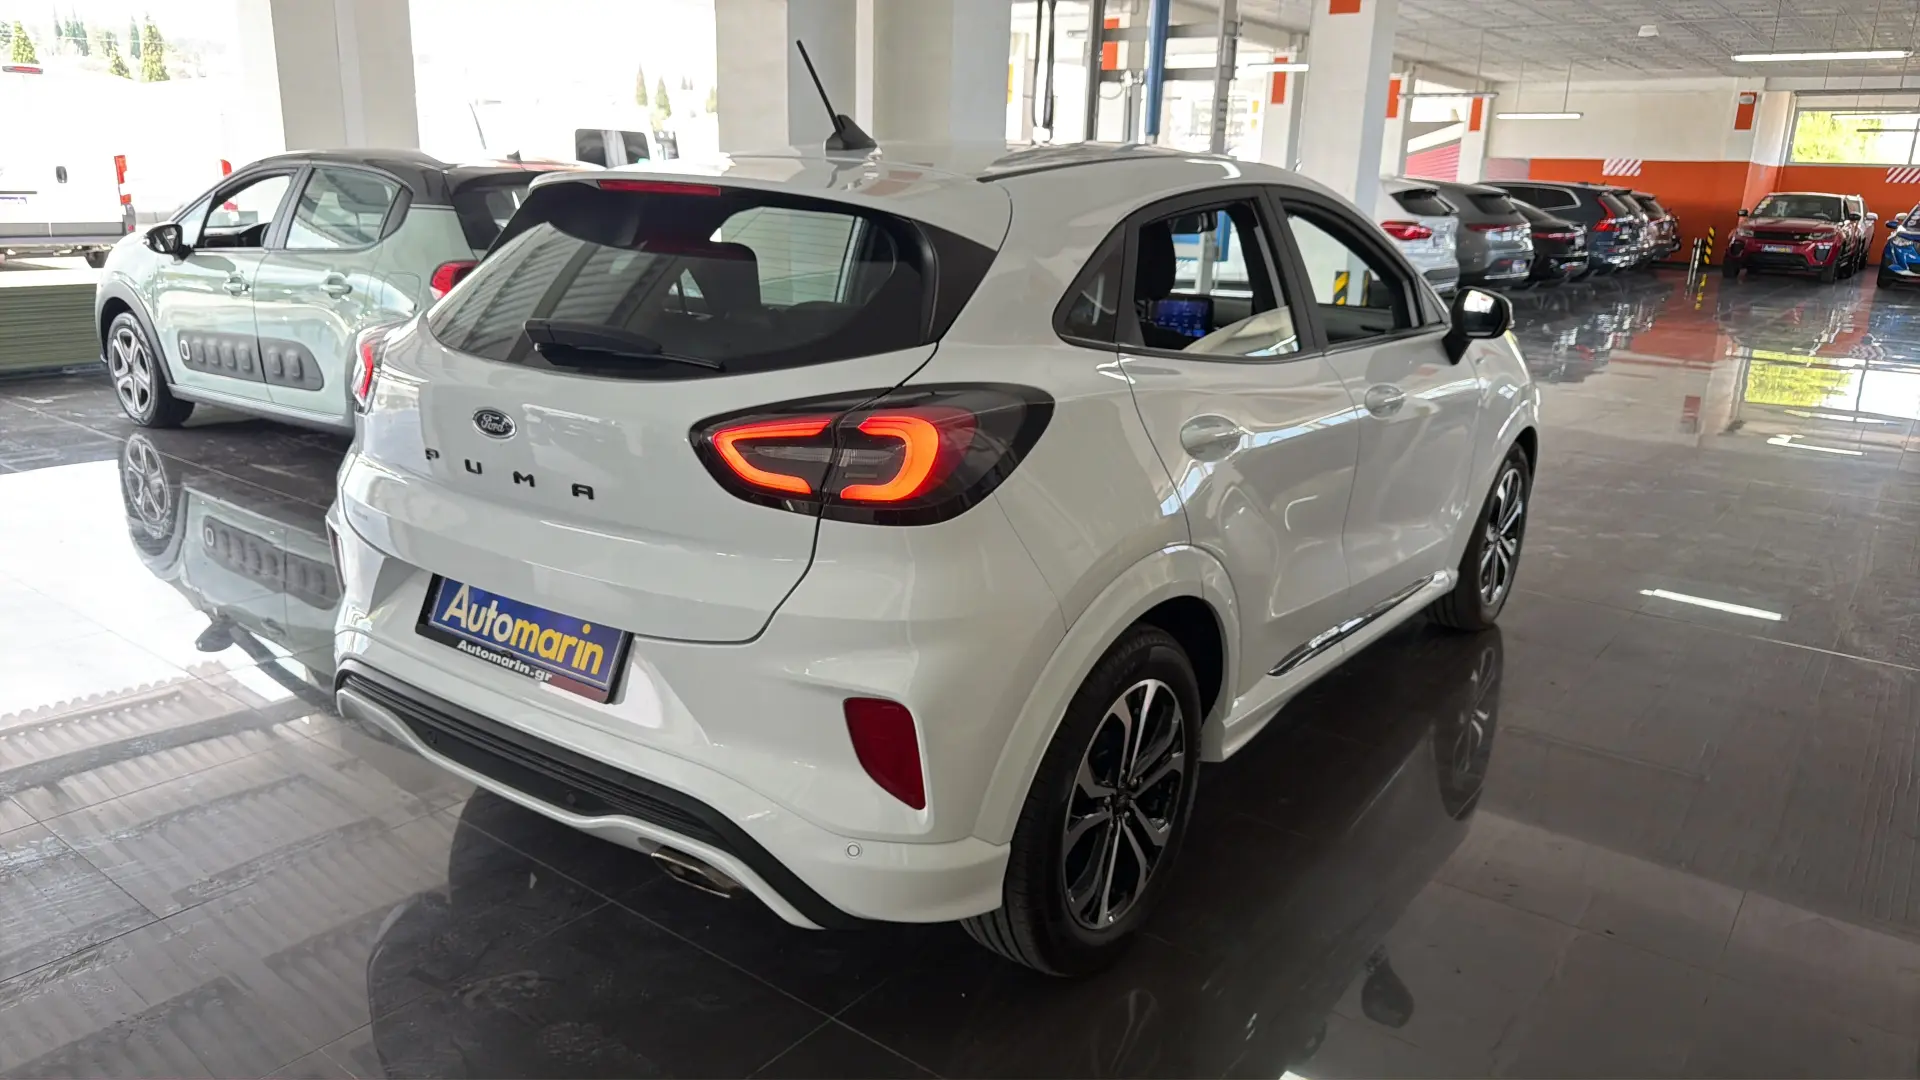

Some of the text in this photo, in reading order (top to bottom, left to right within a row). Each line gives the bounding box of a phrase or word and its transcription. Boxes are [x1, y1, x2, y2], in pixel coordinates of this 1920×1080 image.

[480, 413, 506, 433] Ford
[425, 448, 595, 500] PUMA
[442, 583, 605, 675] Automarin
[457, 639, 553, 683] Automarin.gr
